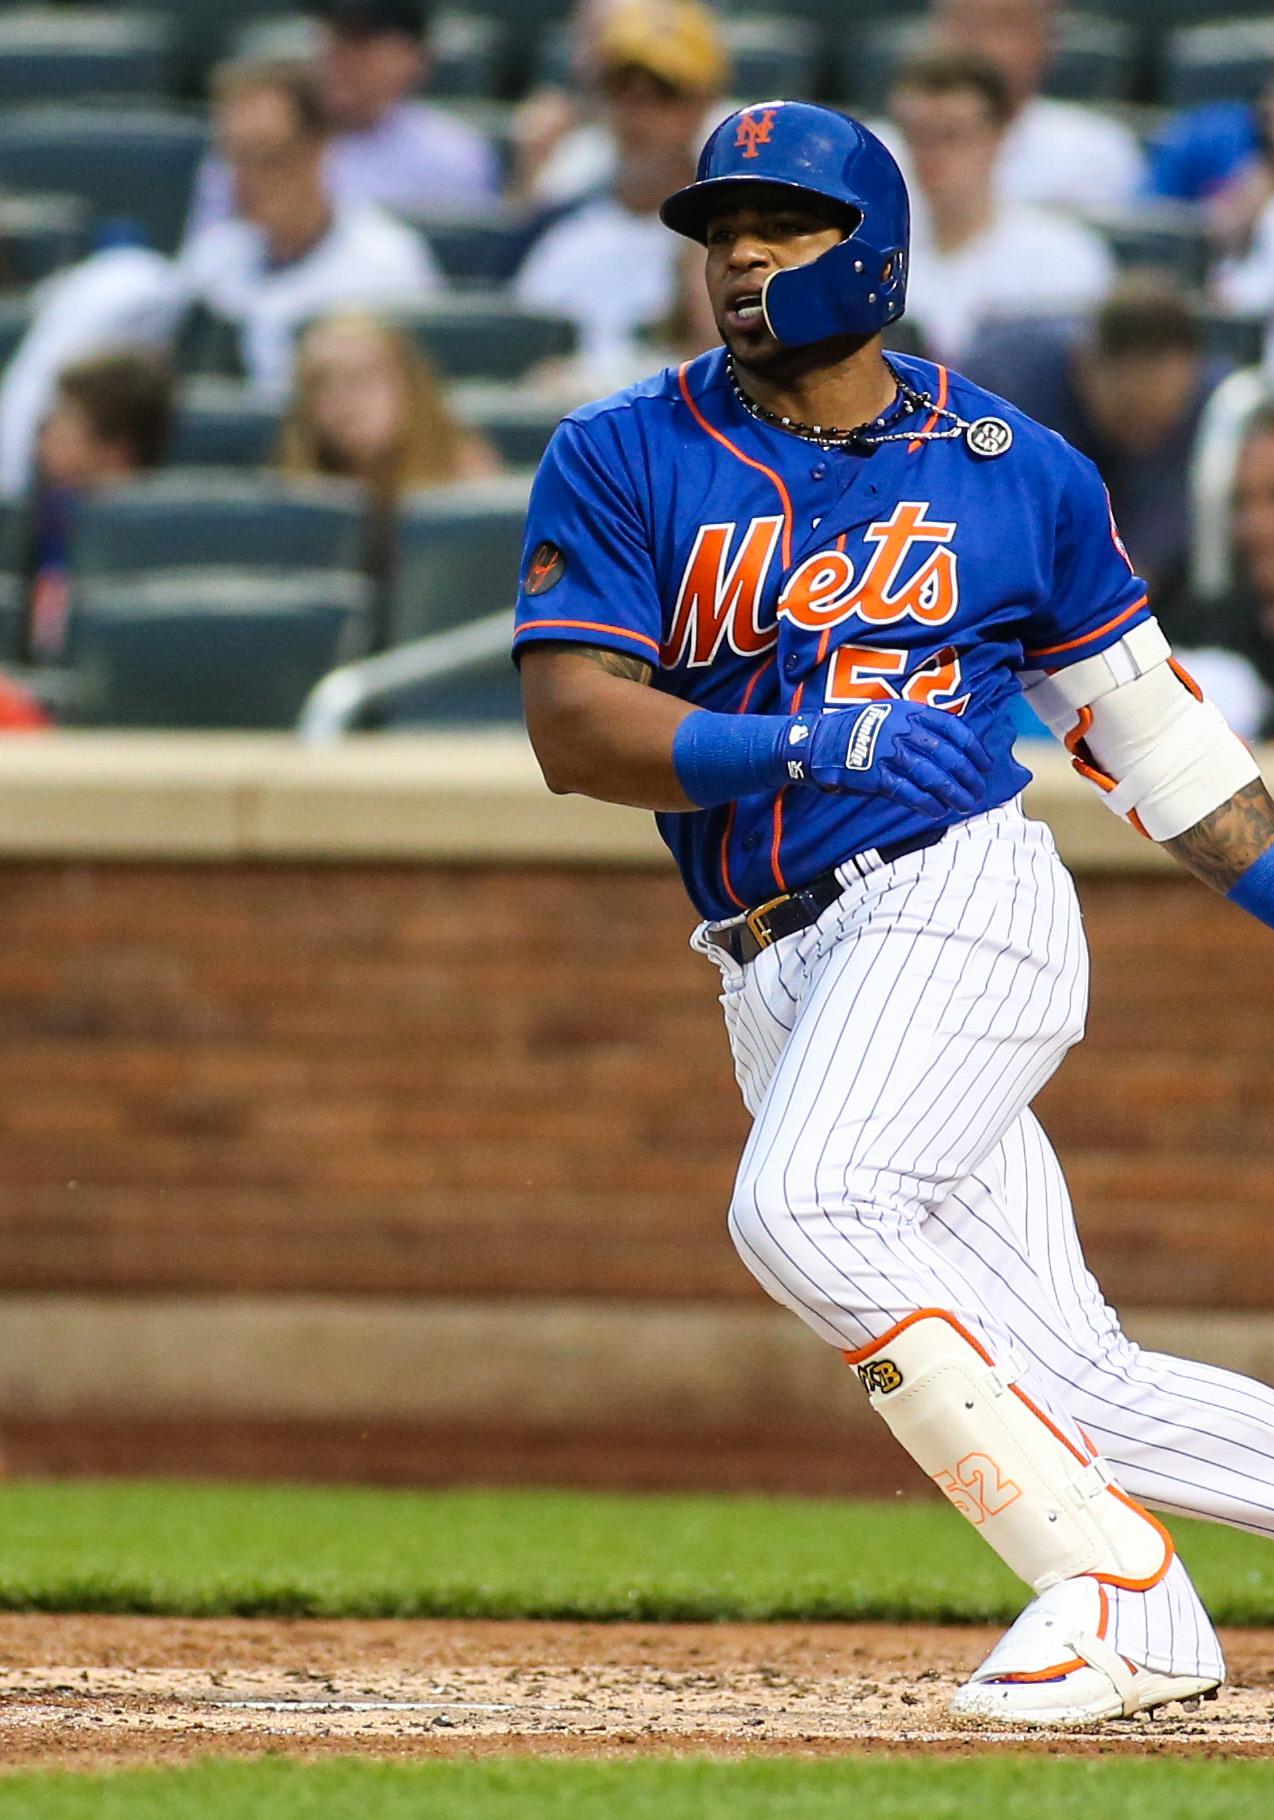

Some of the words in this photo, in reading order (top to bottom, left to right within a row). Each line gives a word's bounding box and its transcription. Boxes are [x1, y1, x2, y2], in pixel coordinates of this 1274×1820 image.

[735, 110, 777, 158] NY
[658, 501, 959, 671] Mets
[849, 706, 886, 767] Franklin
